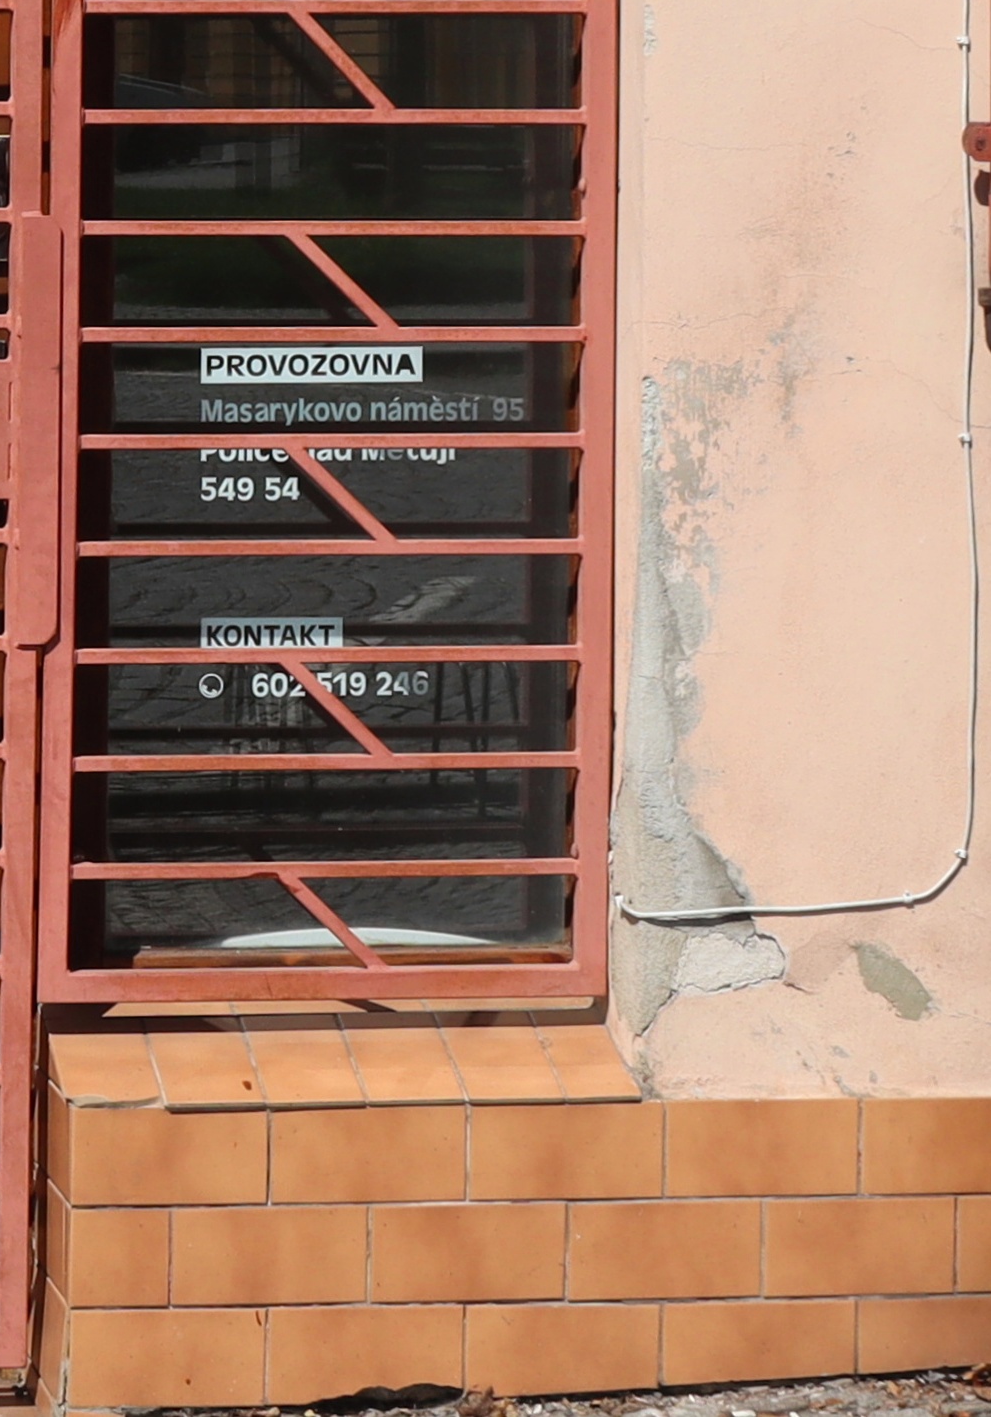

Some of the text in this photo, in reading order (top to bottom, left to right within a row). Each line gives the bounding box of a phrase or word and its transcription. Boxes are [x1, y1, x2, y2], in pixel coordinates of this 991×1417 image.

[206, 354, 416, 377] PROVOZOVNA
[200, 396, 526, 427] Masarykovo náměstí 95
[200, 476, 301, 502] 549 54
[206, 624, 336, 647] KONTAKT
[252, 670, 429, 698] 602 519 246
